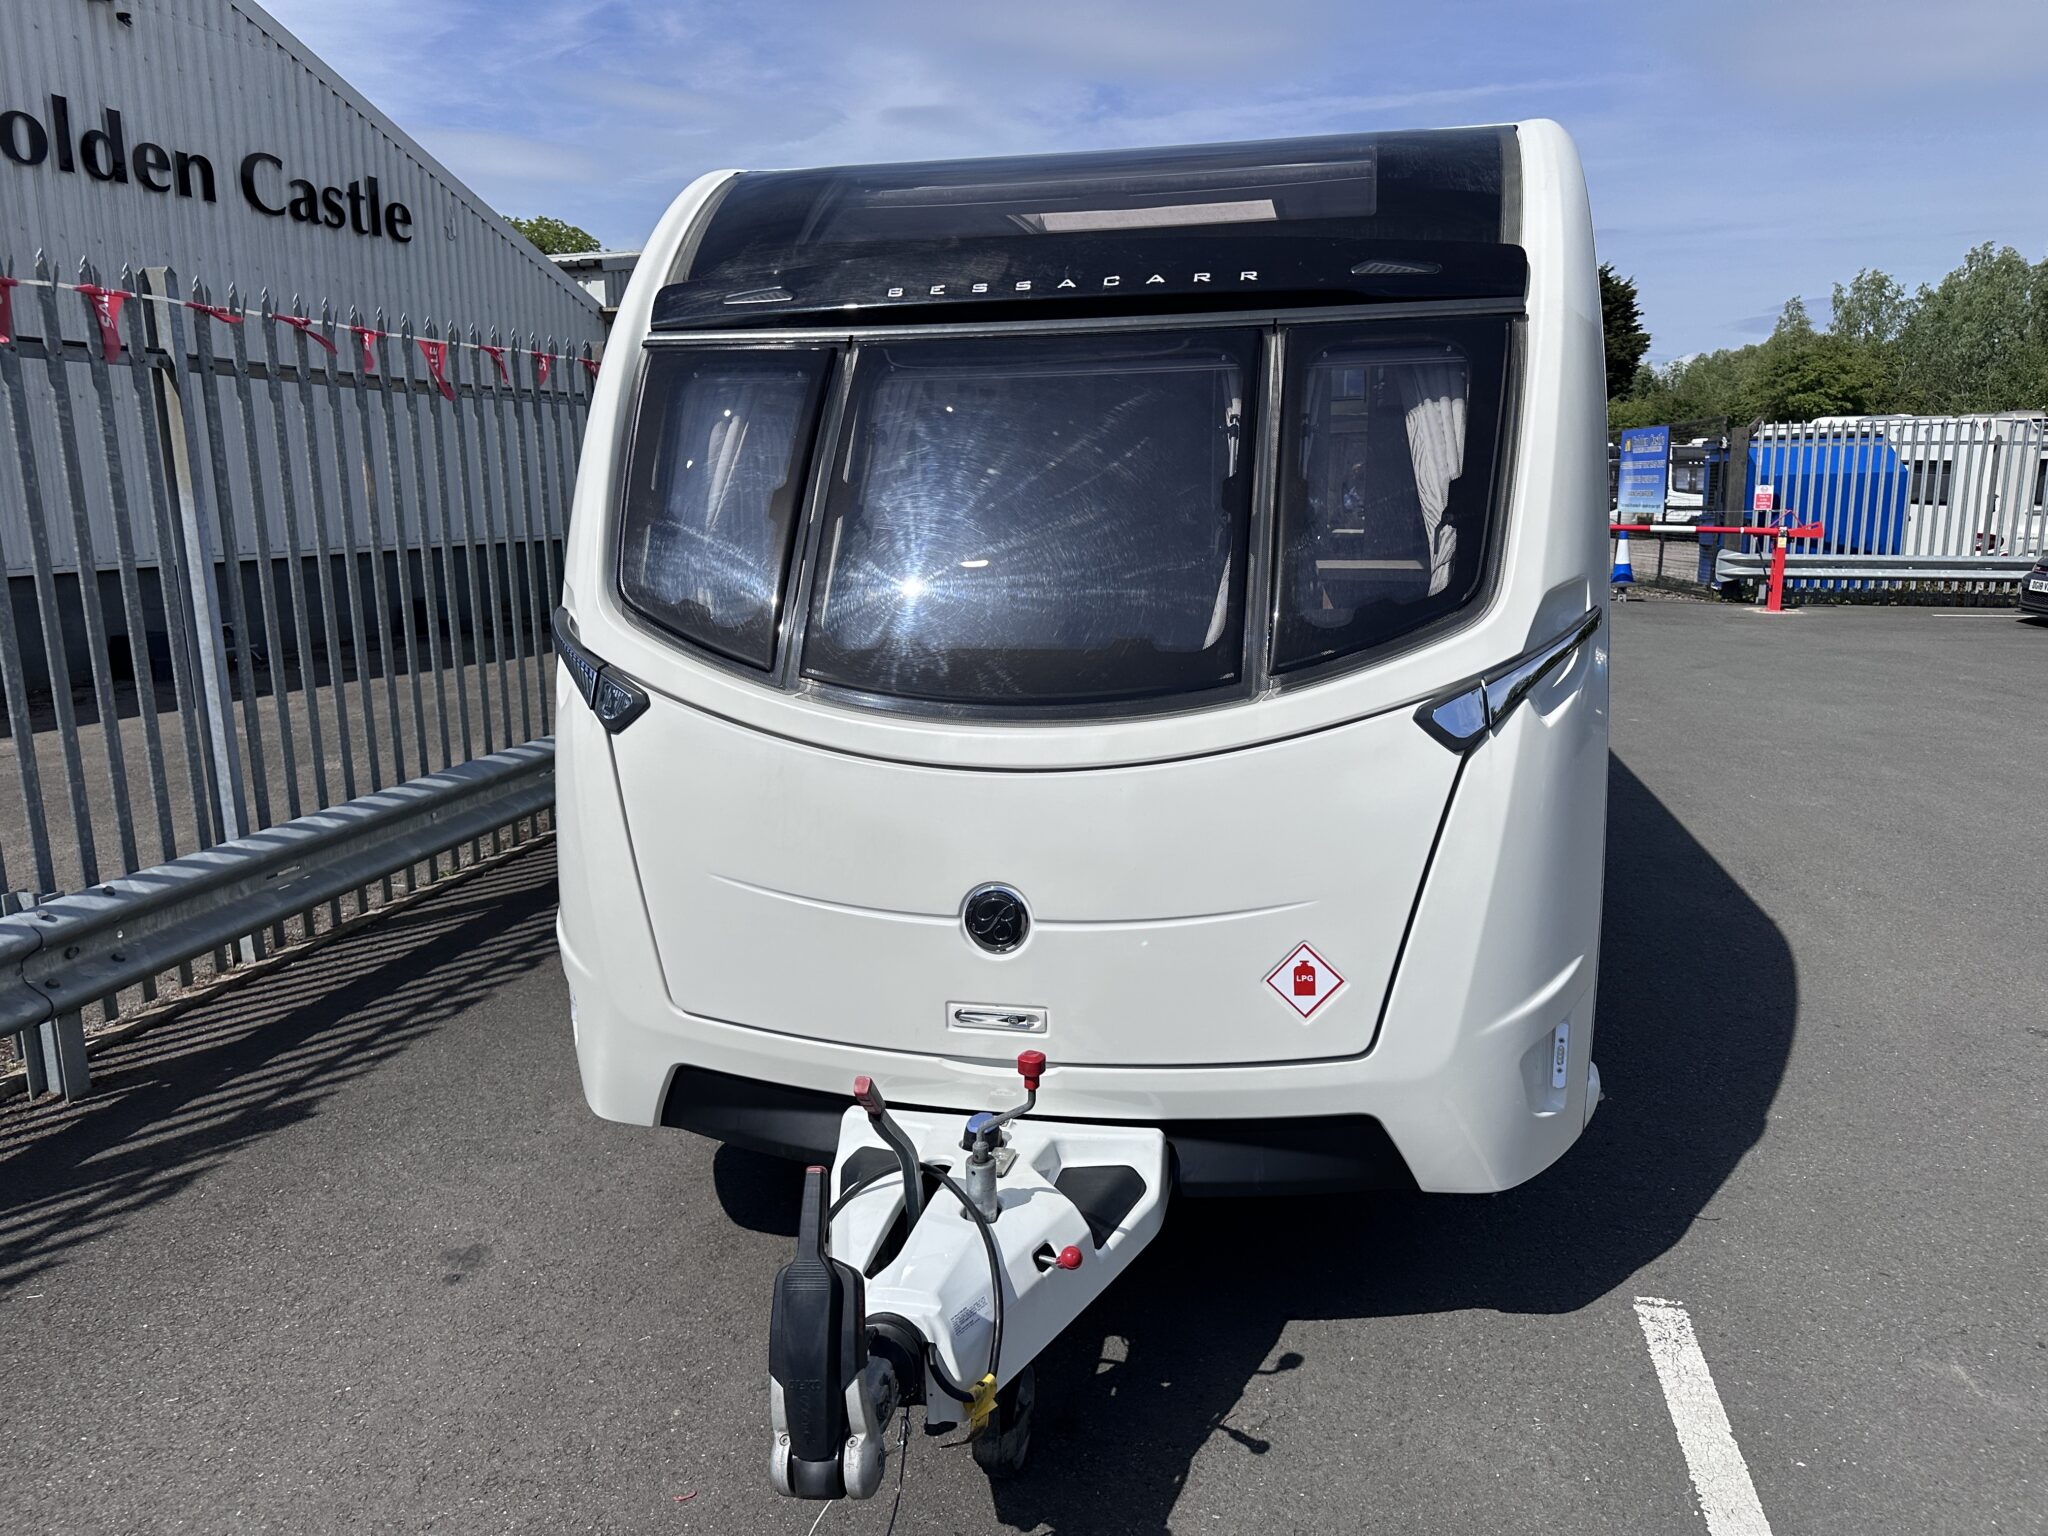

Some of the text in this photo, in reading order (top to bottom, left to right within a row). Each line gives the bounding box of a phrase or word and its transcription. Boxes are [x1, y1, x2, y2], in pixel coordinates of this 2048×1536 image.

[0, 93, 413, 244] olden Castle
[887, 270, 1259, 298] BESSACARR
[1296, 974, 1314, 982] LPG
